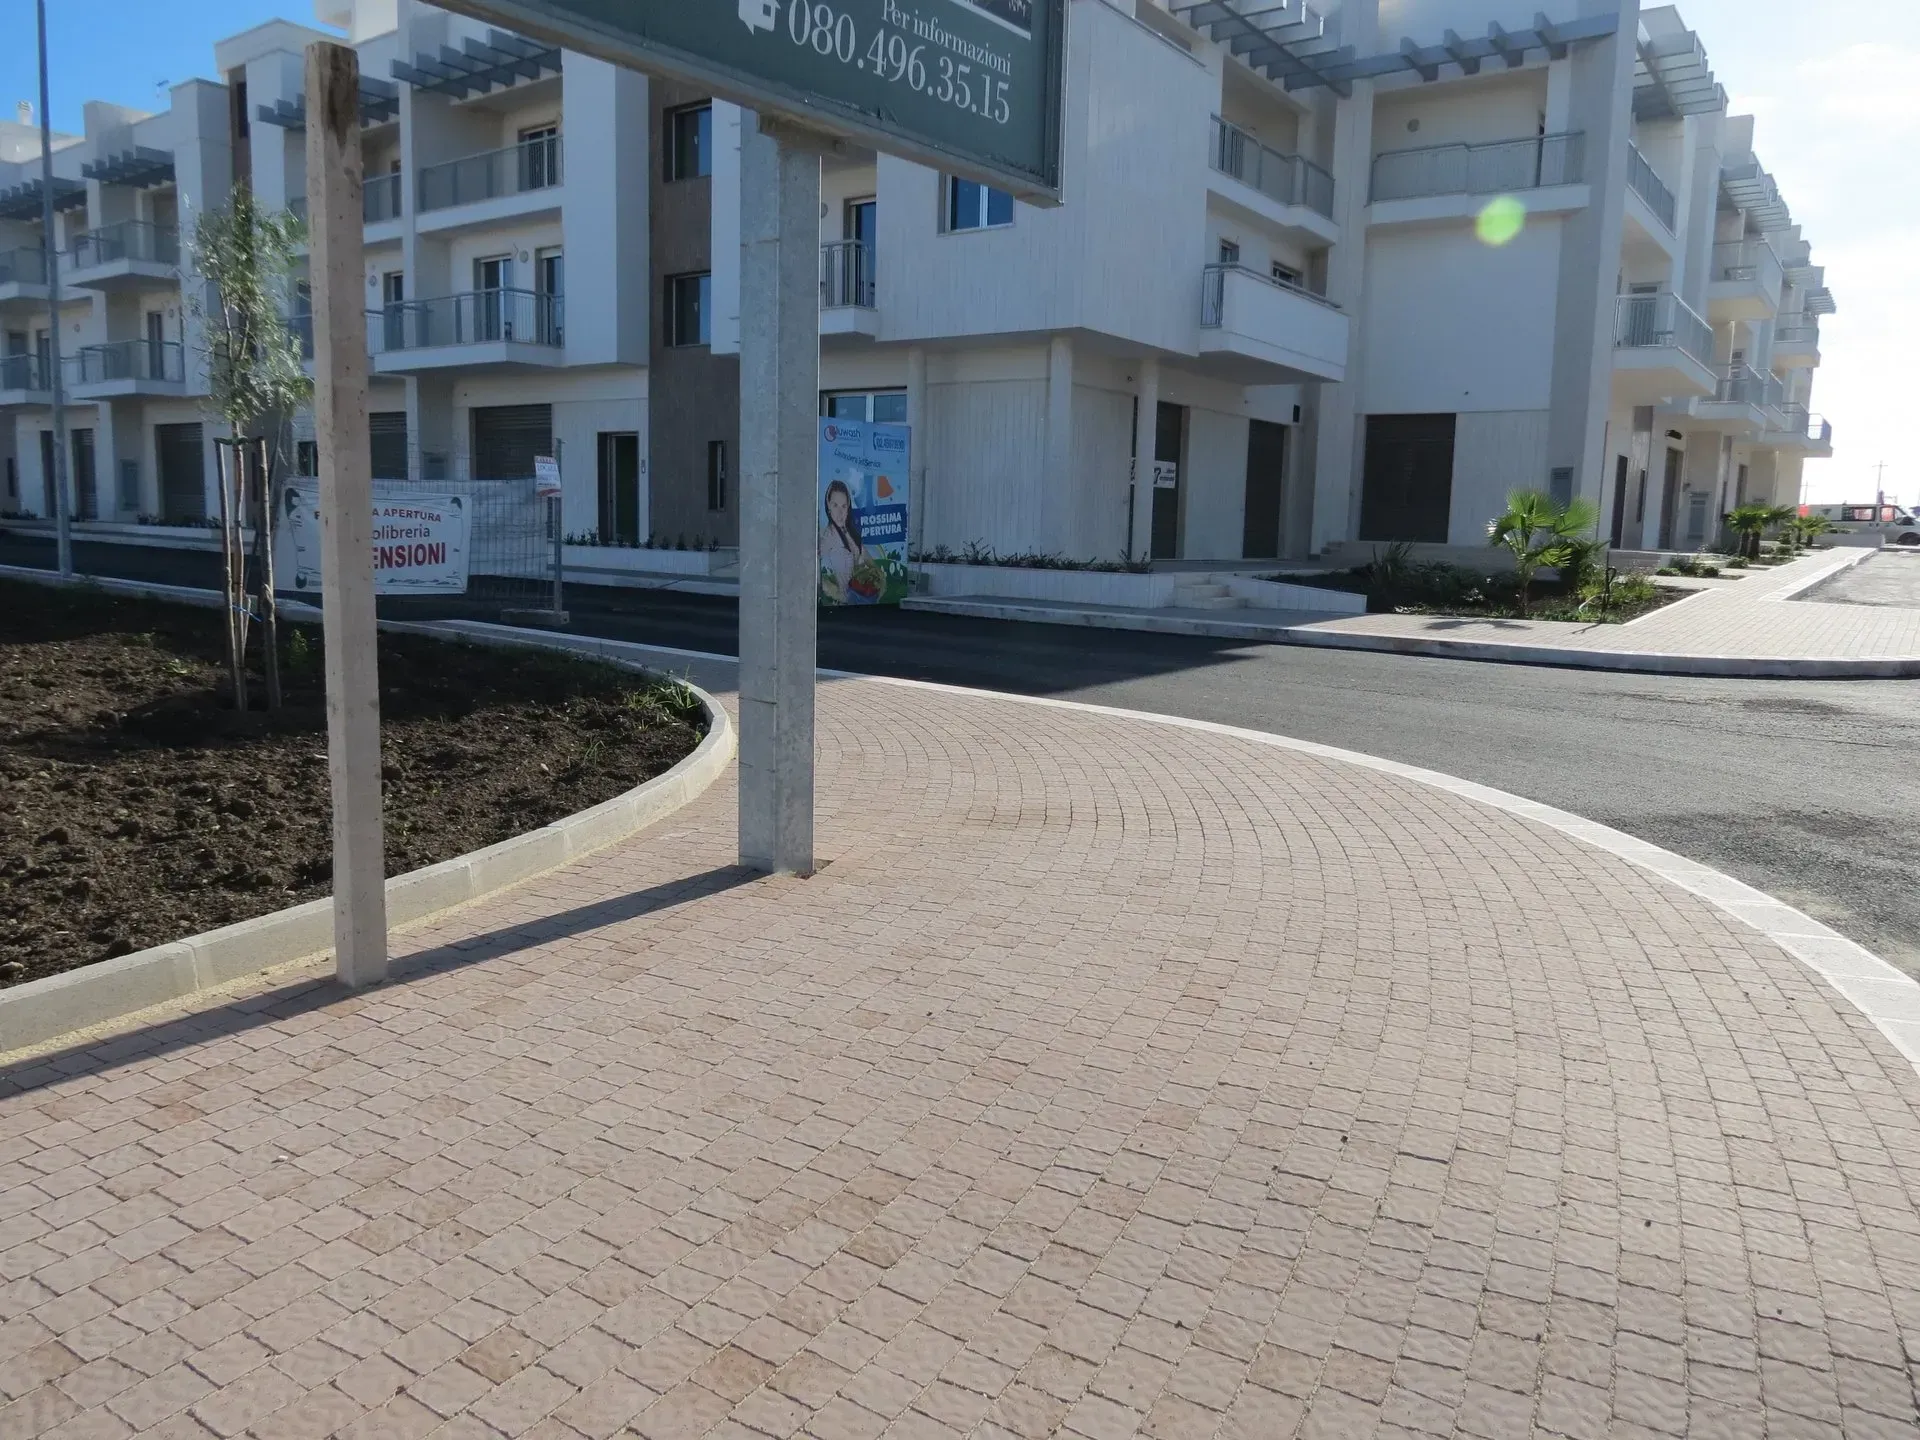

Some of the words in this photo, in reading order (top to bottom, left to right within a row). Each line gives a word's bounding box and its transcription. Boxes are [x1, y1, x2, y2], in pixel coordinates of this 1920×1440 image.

[882, 0, 909, 30] Per
[913, 9, 1012, 76] informazioni
[788, 0, 1011, 124] 080.496.35.15
[383, 508, 441, 522] APERTURA
[860, 511, 902, 526] PROSSIMA
[372, 523, 430, 540] olibreria
[861, 523, 902, 538] APERTURA
[372, 541, 446, 570] ENSIONI
